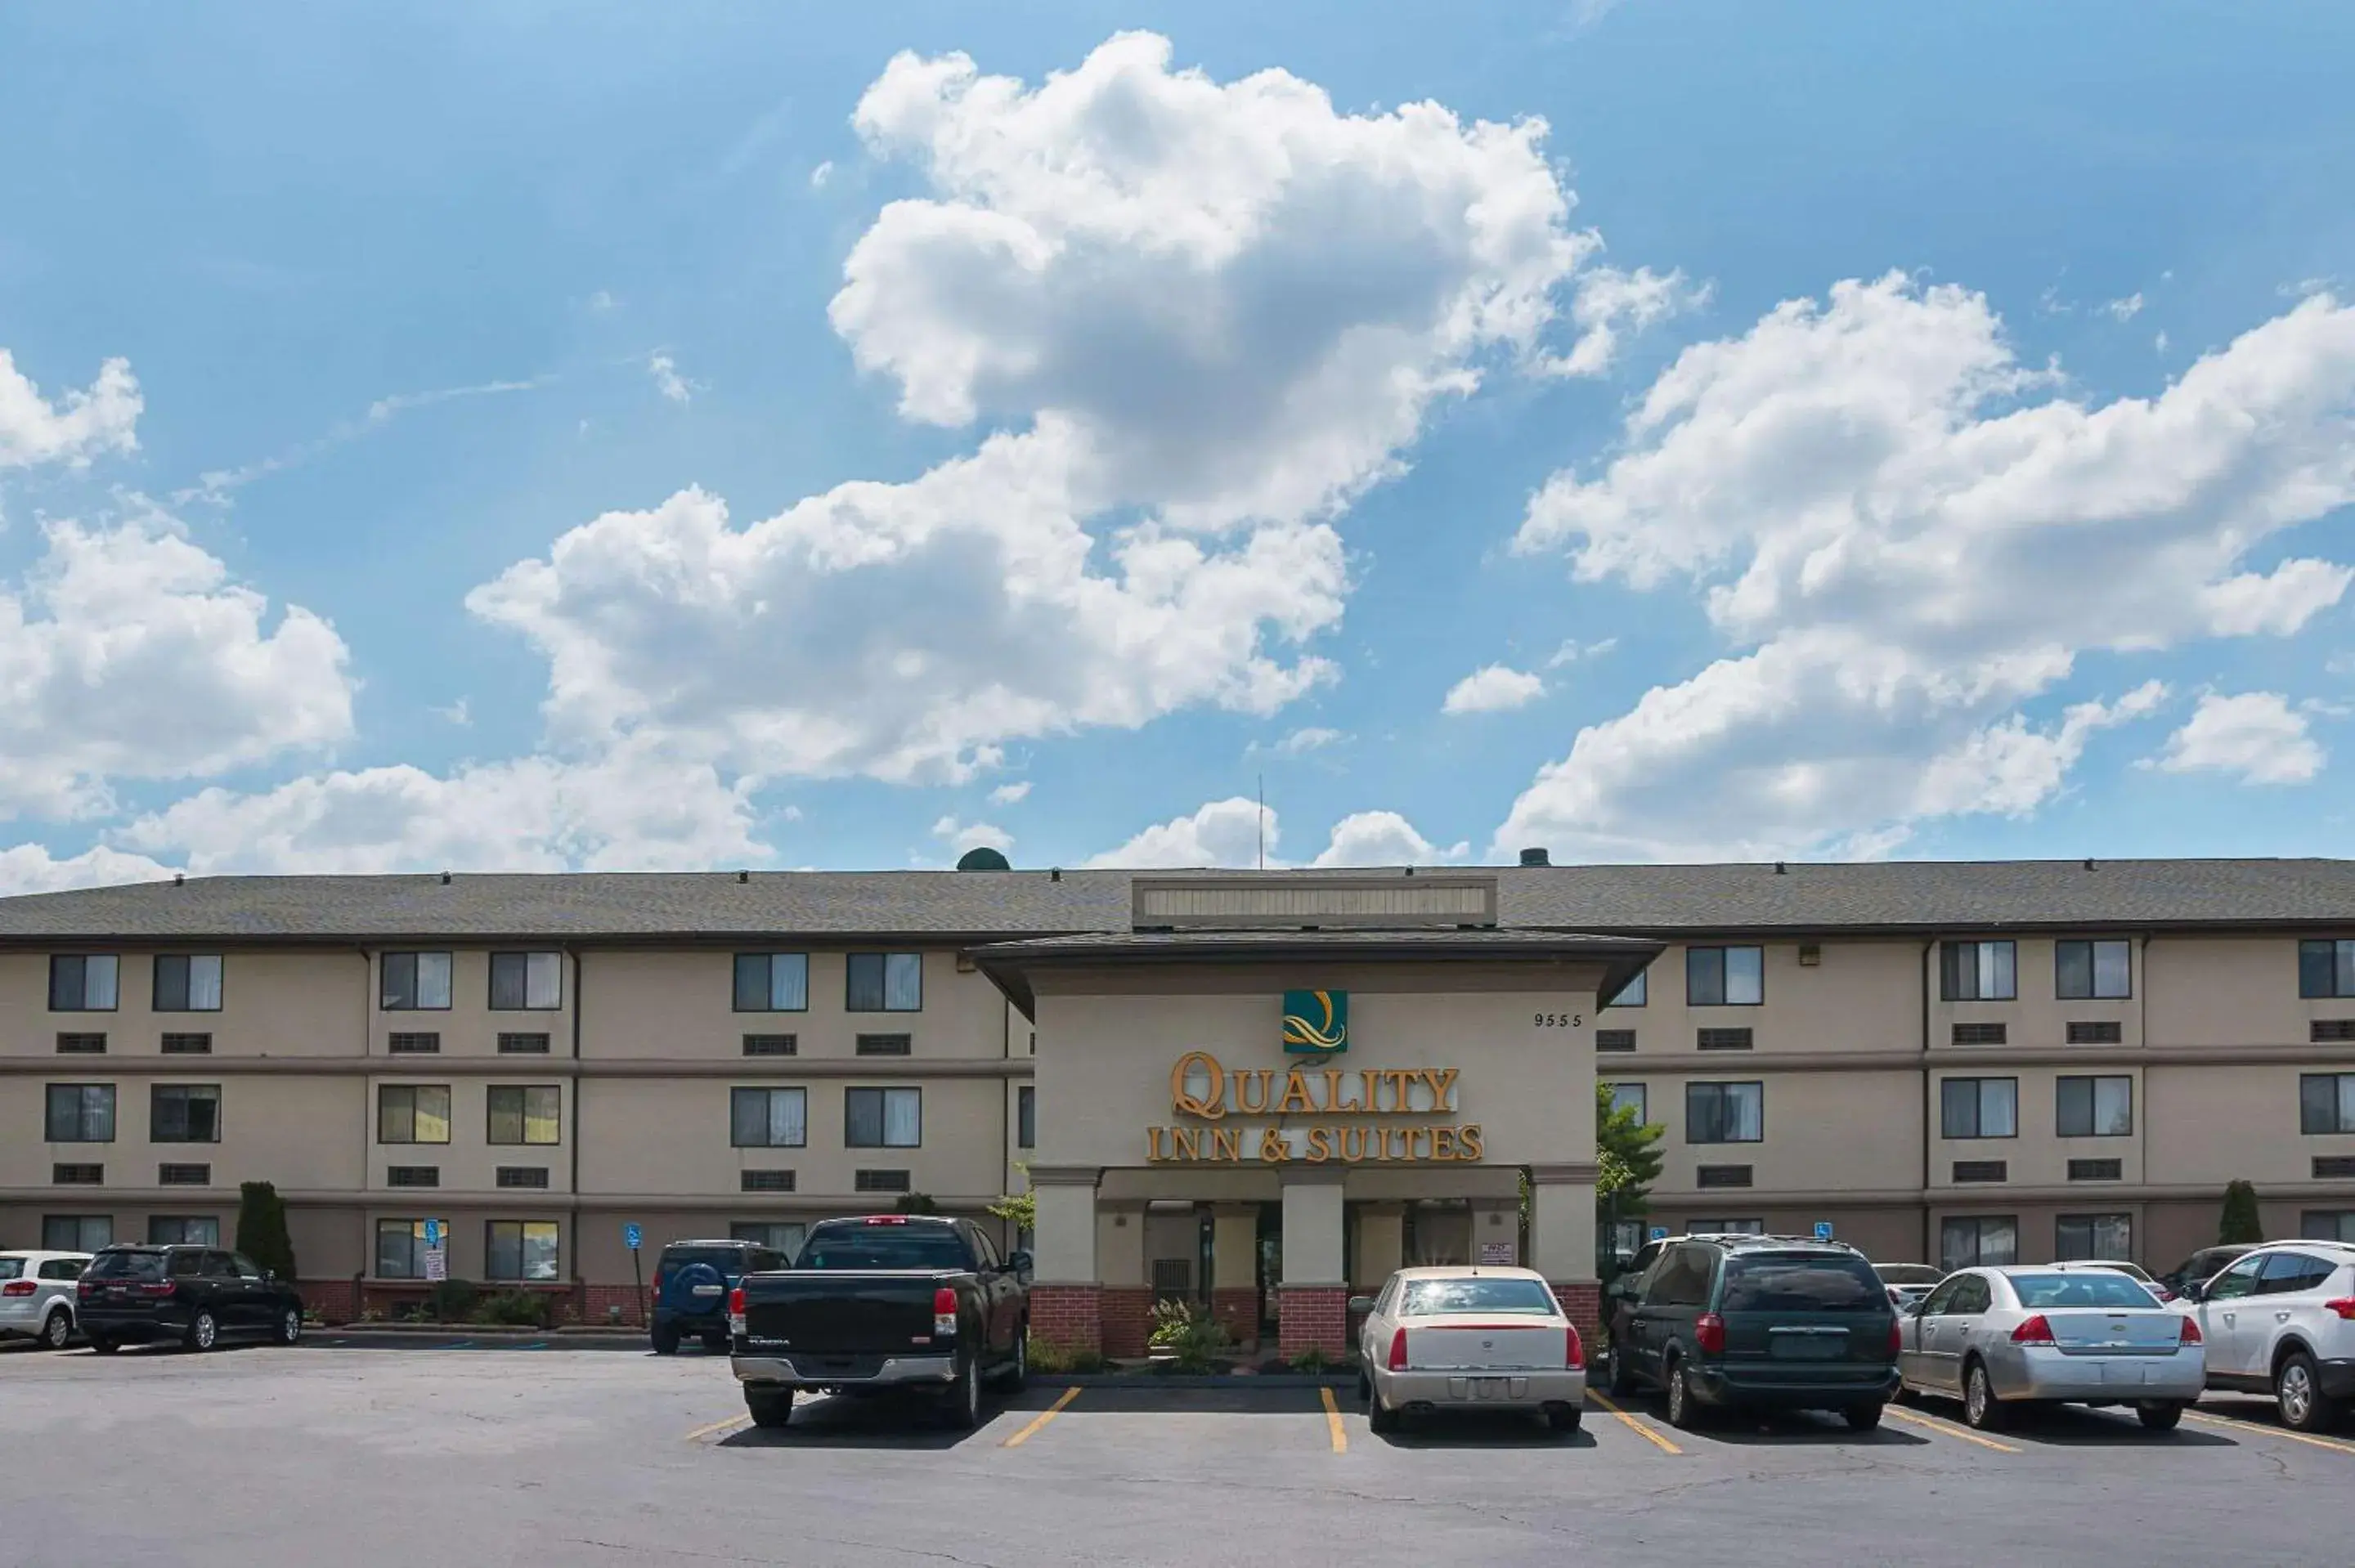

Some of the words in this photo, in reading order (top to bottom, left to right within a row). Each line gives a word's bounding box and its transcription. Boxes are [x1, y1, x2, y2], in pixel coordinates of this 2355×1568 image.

[1535, 1013, 1581, 1028] 9555
[1171, 1051, 1460, 1120] QUALITY
[1147, 1127, 1241, 1162] INN
[1259, 1127, 1291, 1163] &
[1306, 1124, 1484, 1163] SUITES
